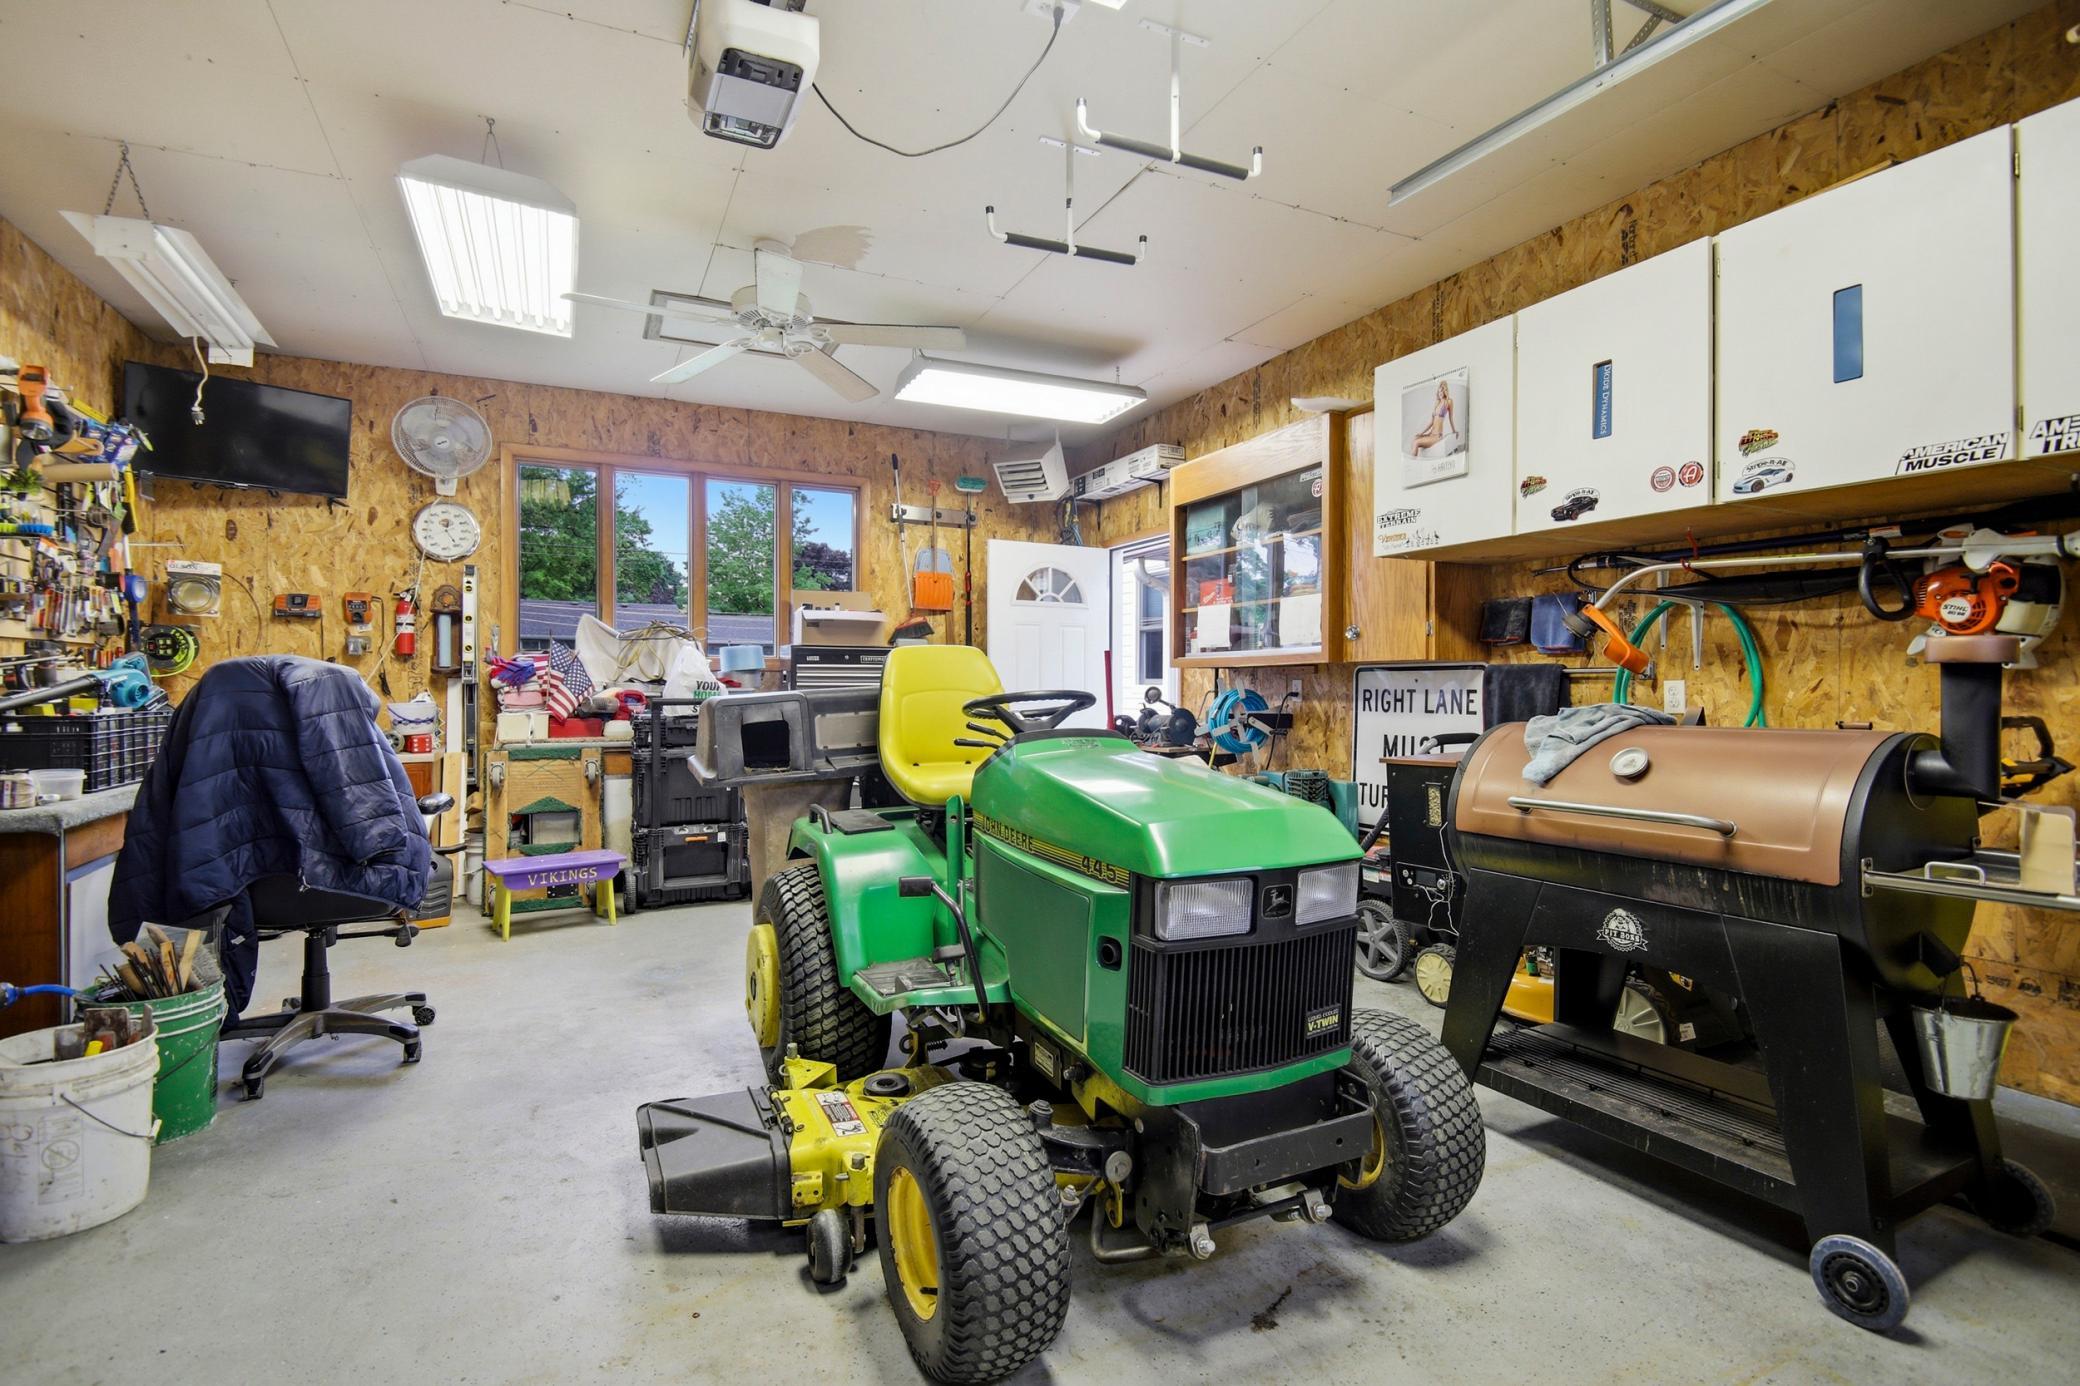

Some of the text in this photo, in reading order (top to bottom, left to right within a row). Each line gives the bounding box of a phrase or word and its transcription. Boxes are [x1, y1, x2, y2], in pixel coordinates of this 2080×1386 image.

[1600, 364, 1611, 435] DIODE DYNAMICS
[1902, 432, 2010, 460] AMERICAN
[2043, 431, 2080, 454] TR
[1904, 447, 1998, 472] MUSCLE
[1943, 603, 1968, 612] STIHL
[1362, 688, 1478, 716] RIGHT LANE
[1383, 734, 1444, 758] MU
[982, 815, 1033, 853] JOHN DEERE
[527, 866, 598, 886] VIKINGS
[1081, 855, 1118, 882] 445
[1604, 929, 1641, 943] PIT BOSS
